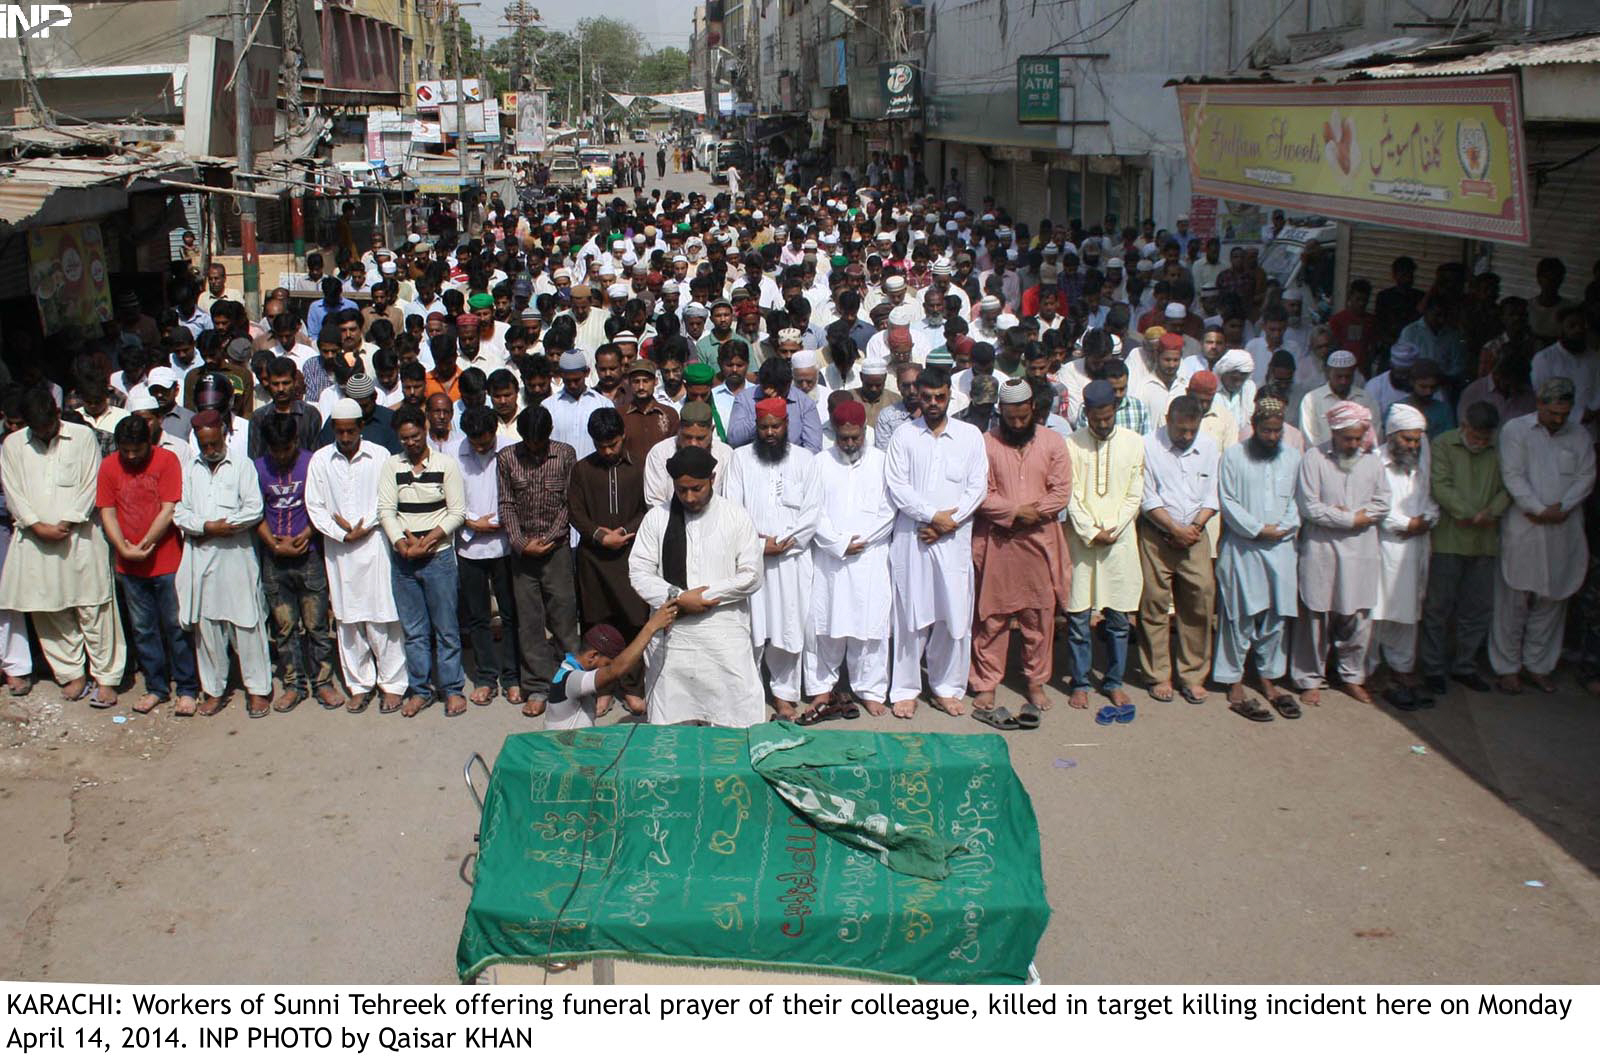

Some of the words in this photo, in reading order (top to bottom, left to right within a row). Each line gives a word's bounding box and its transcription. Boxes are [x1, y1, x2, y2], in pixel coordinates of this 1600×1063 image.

[1022, 63, 1054, 75] HBL
[1023, 77, 1054, 90] ATM
[1265, 115, 1320, 165] Sweets
[1283, 228, 1309, 240] POLICE
